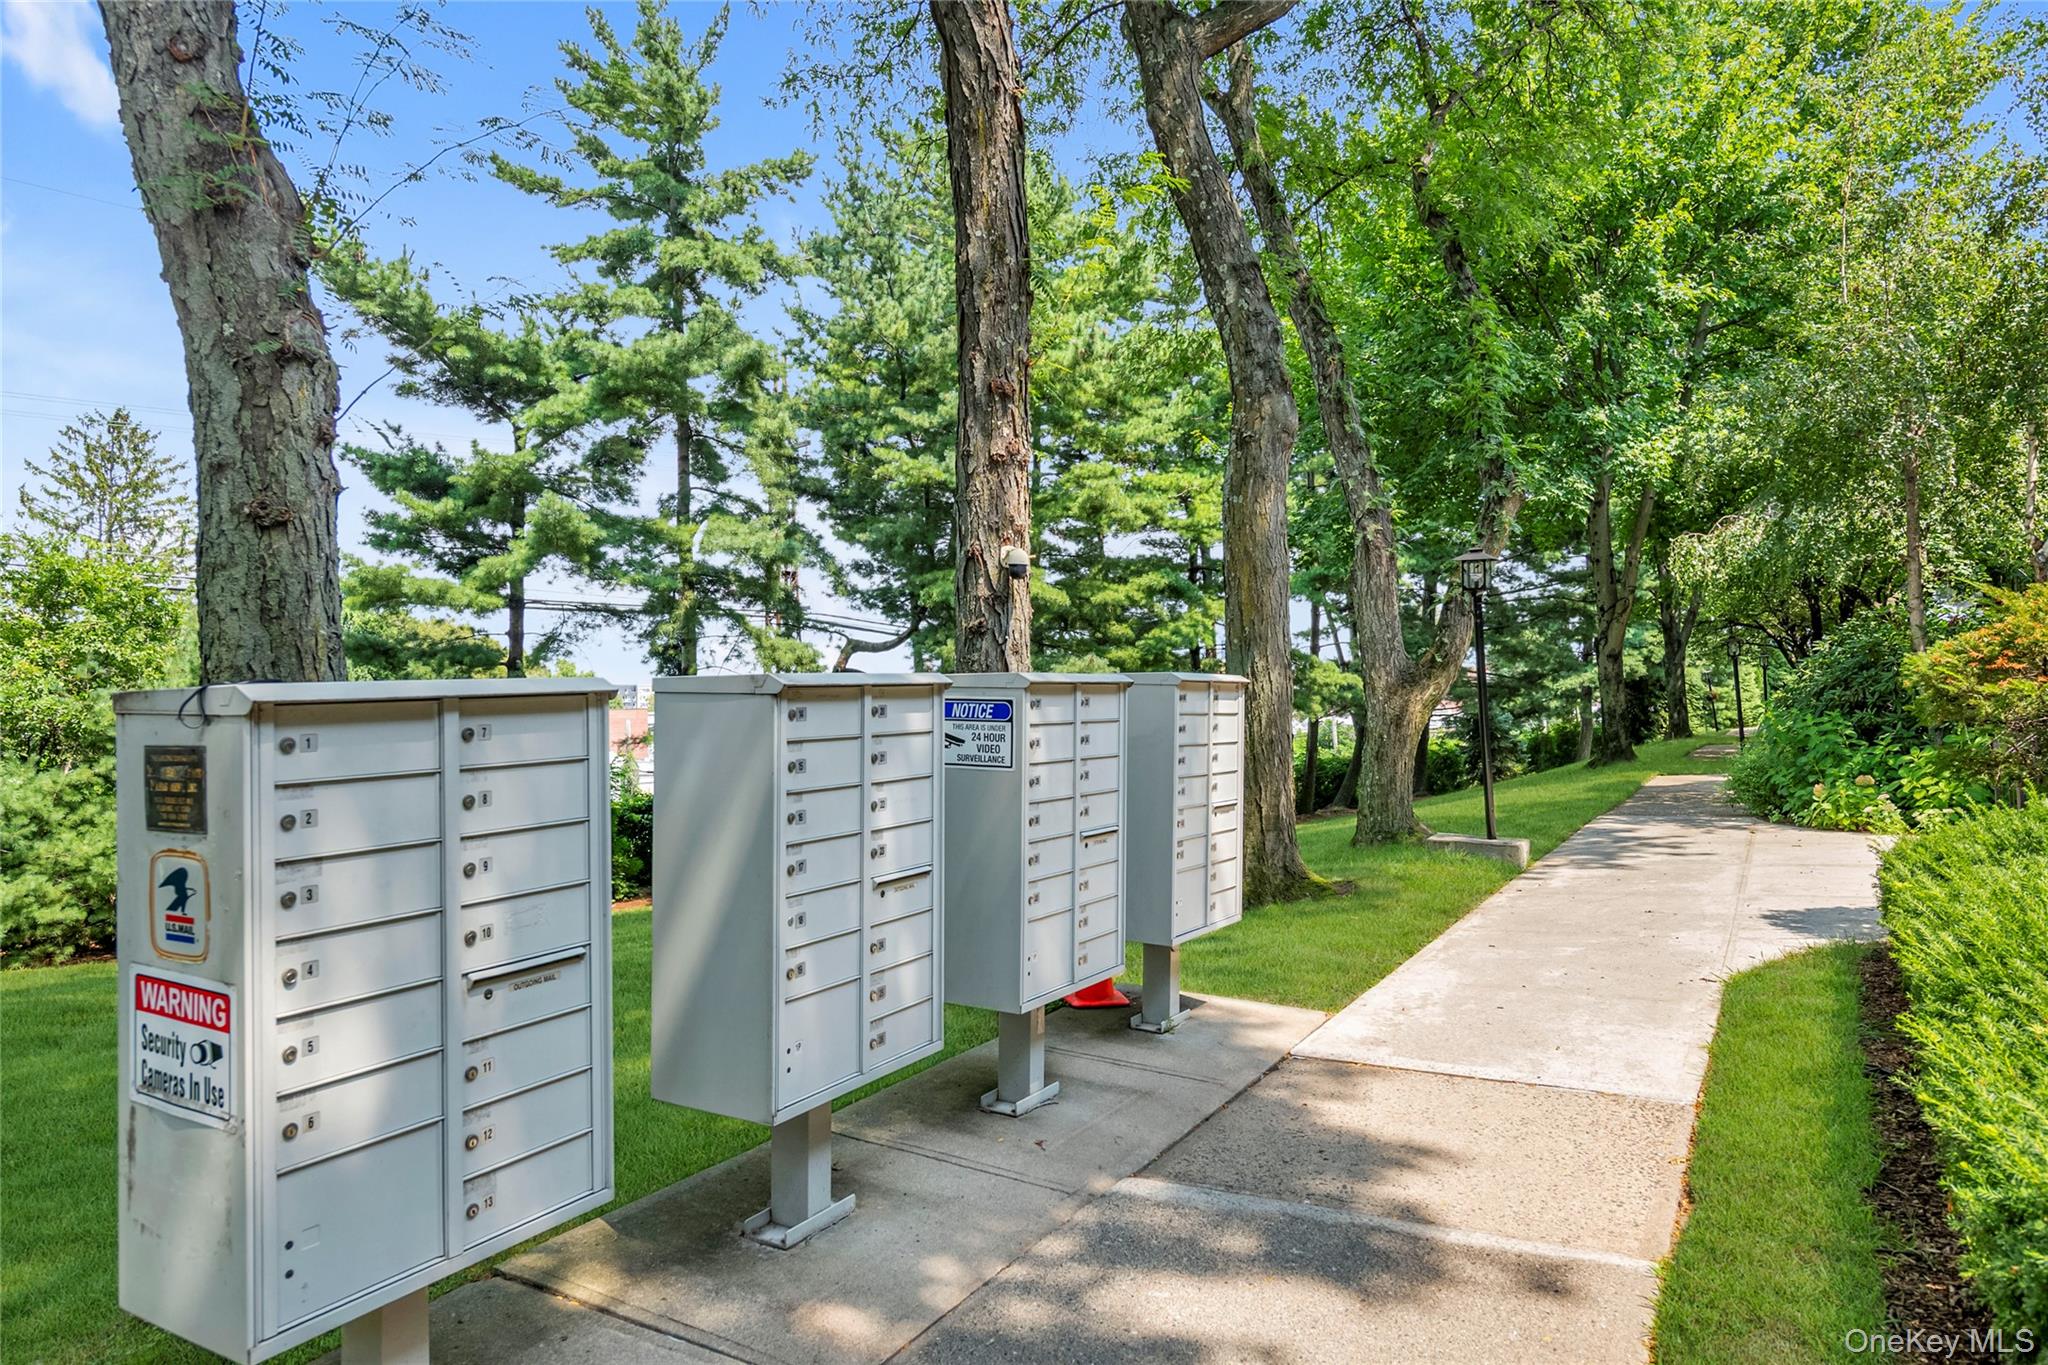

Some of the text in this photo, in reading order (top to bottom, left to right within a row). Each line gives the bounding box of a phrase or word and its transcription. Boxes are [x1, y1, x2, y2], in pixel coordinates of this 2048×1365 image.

[952, 703, 994, 718] NOTICE
[482, 727, 487, 738] 7
[953, 723, 964, 731] THIS
[965, 723, 980, 731] AREA
[987, 724, 1006, 732] UNDER
[305, 737, 311, 750] 1
[971, 732, 1006, 743] 24 HOUR
[976, 744, 1000, 754] VIDEO
[957, 753, 1005, 764] SURVEILLANCE
[483, 794, 488, 805] 8
[306, 813, 312, 825] 2
[483, 861, 489, 871] 9
[306, 889, 313, 901] 3
[482, 926, 491, 939] 10
[307, 964, 313, 976] 4
[543, 974, 556, 982] MAIL
[140, 980, 227, 1028] WARNING
[141, 1023, 187, 1067] Security
[308, 1040, 314, 1053] 5
[483, 1062, 492, 1072] 11
[141, 1059, 224, 1108] Cameras In Use
[308, 1116, 314, 1129] 6
[483, 1128, 492, 1140] 12
[484, 1196, 493, 1209] 13
